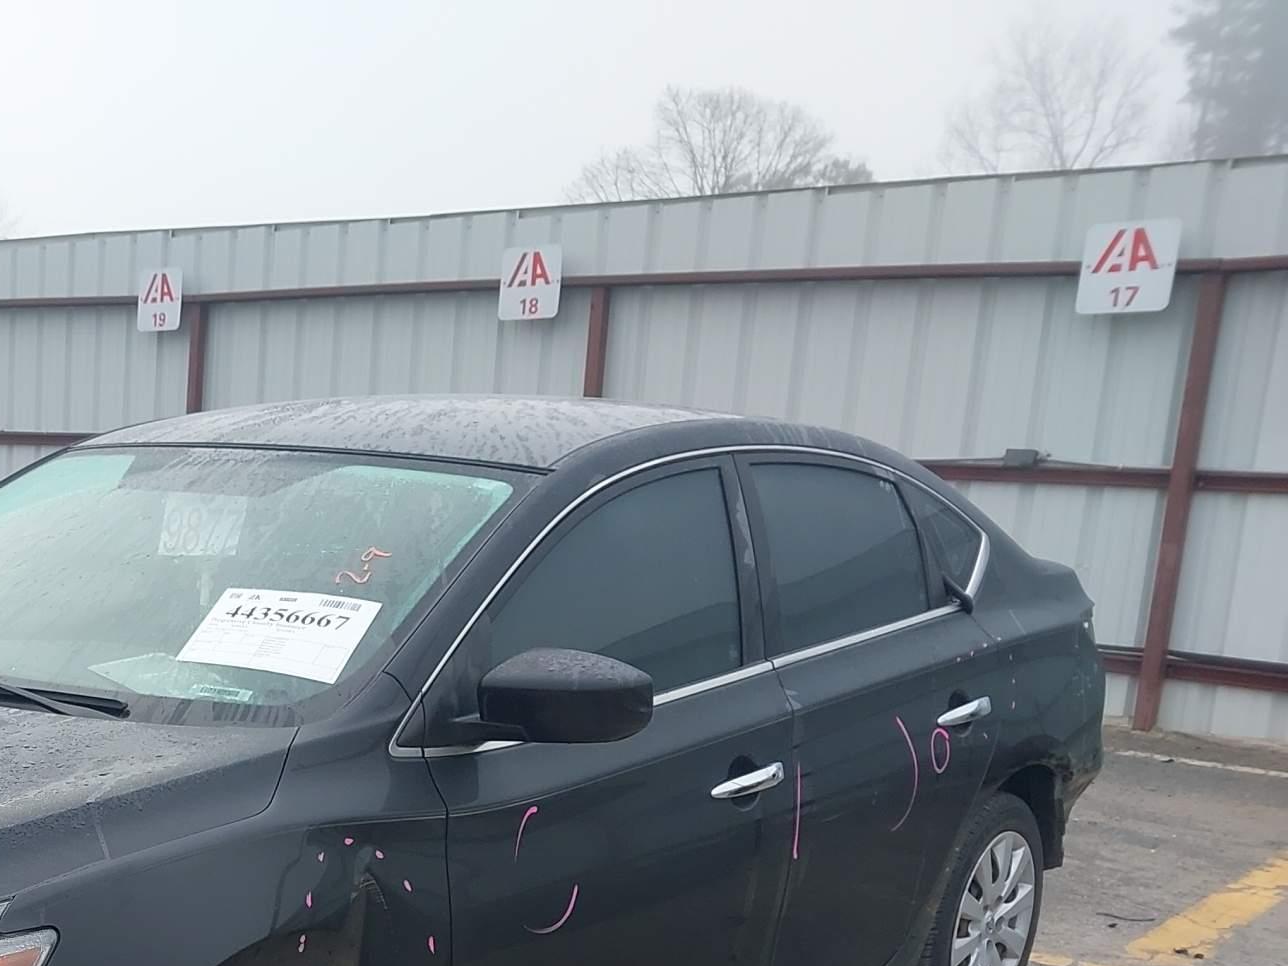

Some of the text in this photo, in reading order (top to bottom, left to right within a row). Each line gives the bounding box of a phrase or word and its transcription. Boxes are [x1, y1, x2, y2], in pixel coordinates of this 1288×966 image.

[519, 297, 539, 316] 18
[1110, 286, 1140, 308] 17
[152, 312, 166, 328] 19
[225, 604, 352, 630] 44356667
